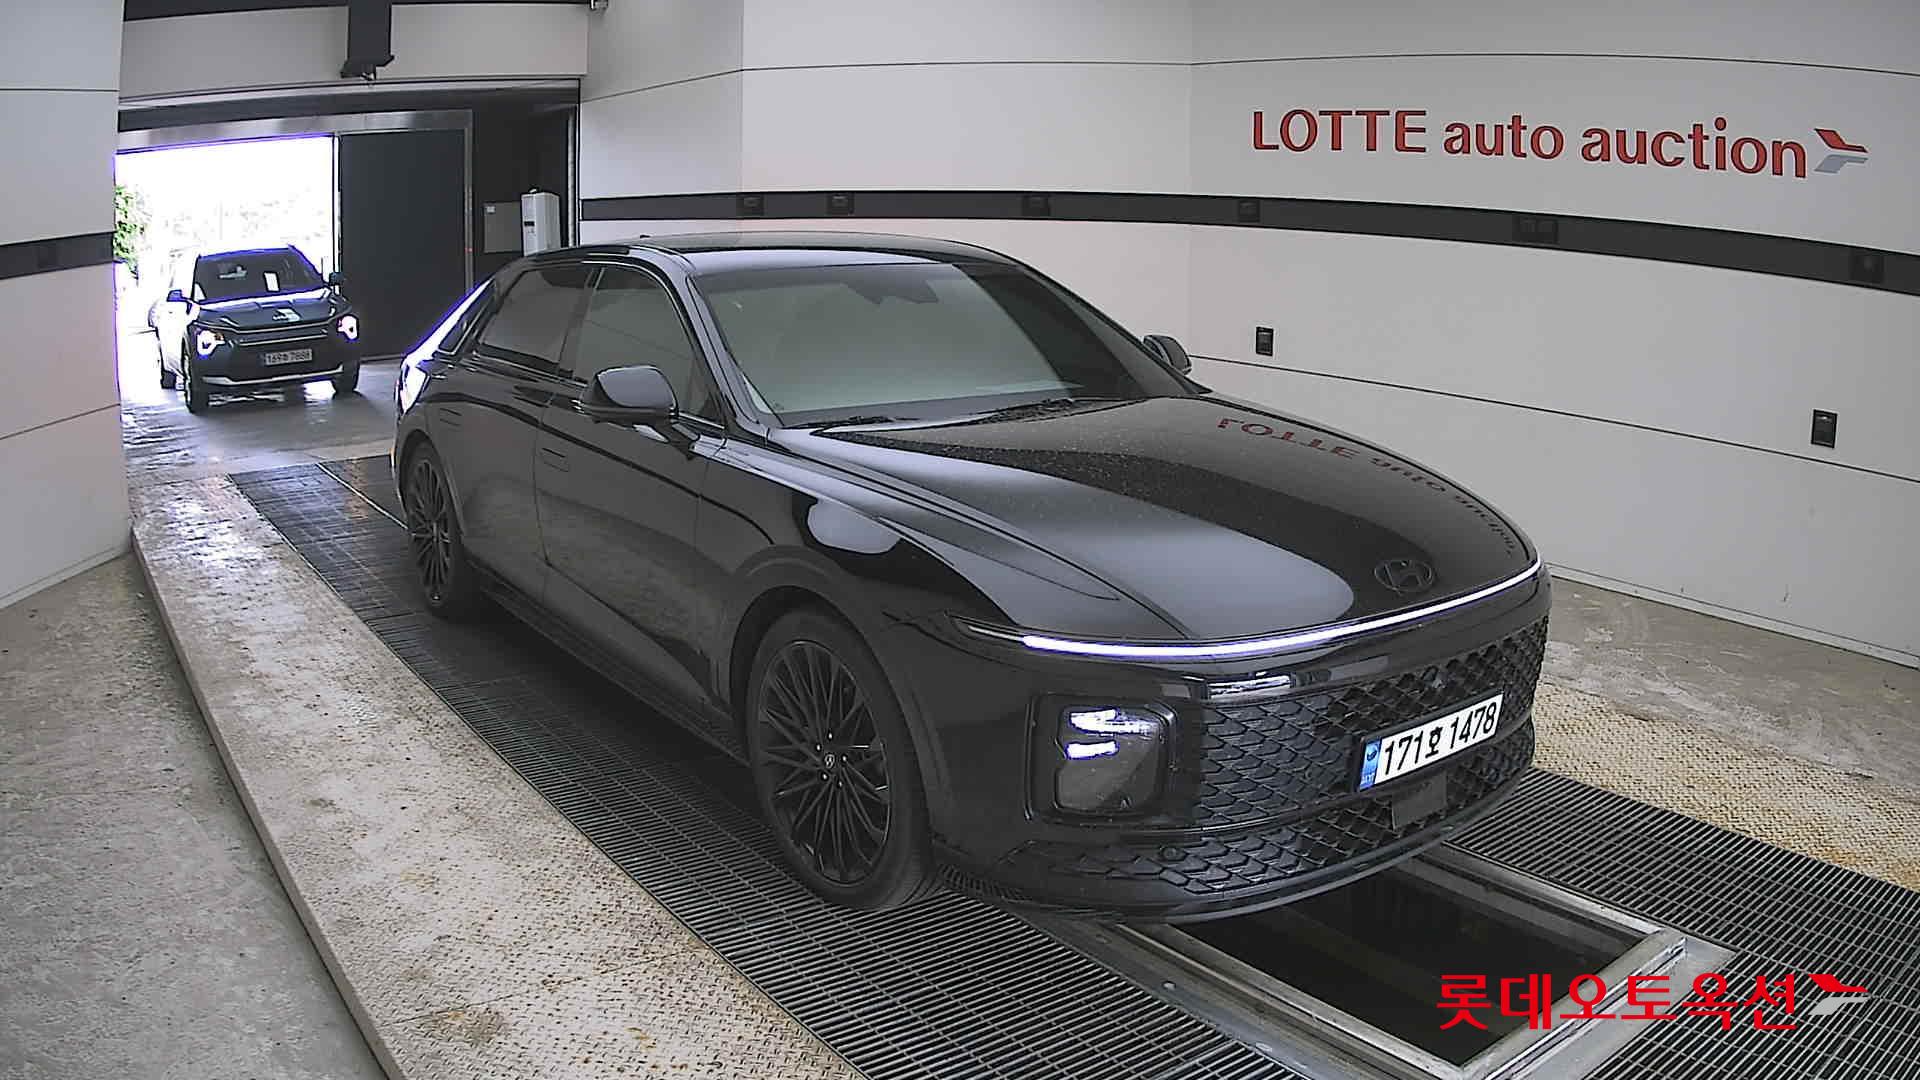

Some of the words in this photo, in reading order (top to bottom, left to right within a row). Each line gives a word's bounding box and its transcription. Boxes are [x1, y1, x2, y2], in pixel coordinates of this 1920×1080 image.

[1253, 109, 1426, 153] LOTTE
[1443, 114, 1565, 160] auto
[1581, 117, 1808, 178] auction
[1384, 726, 1444, 776] 171호
[1449, 701, 1498, 750] 1478
